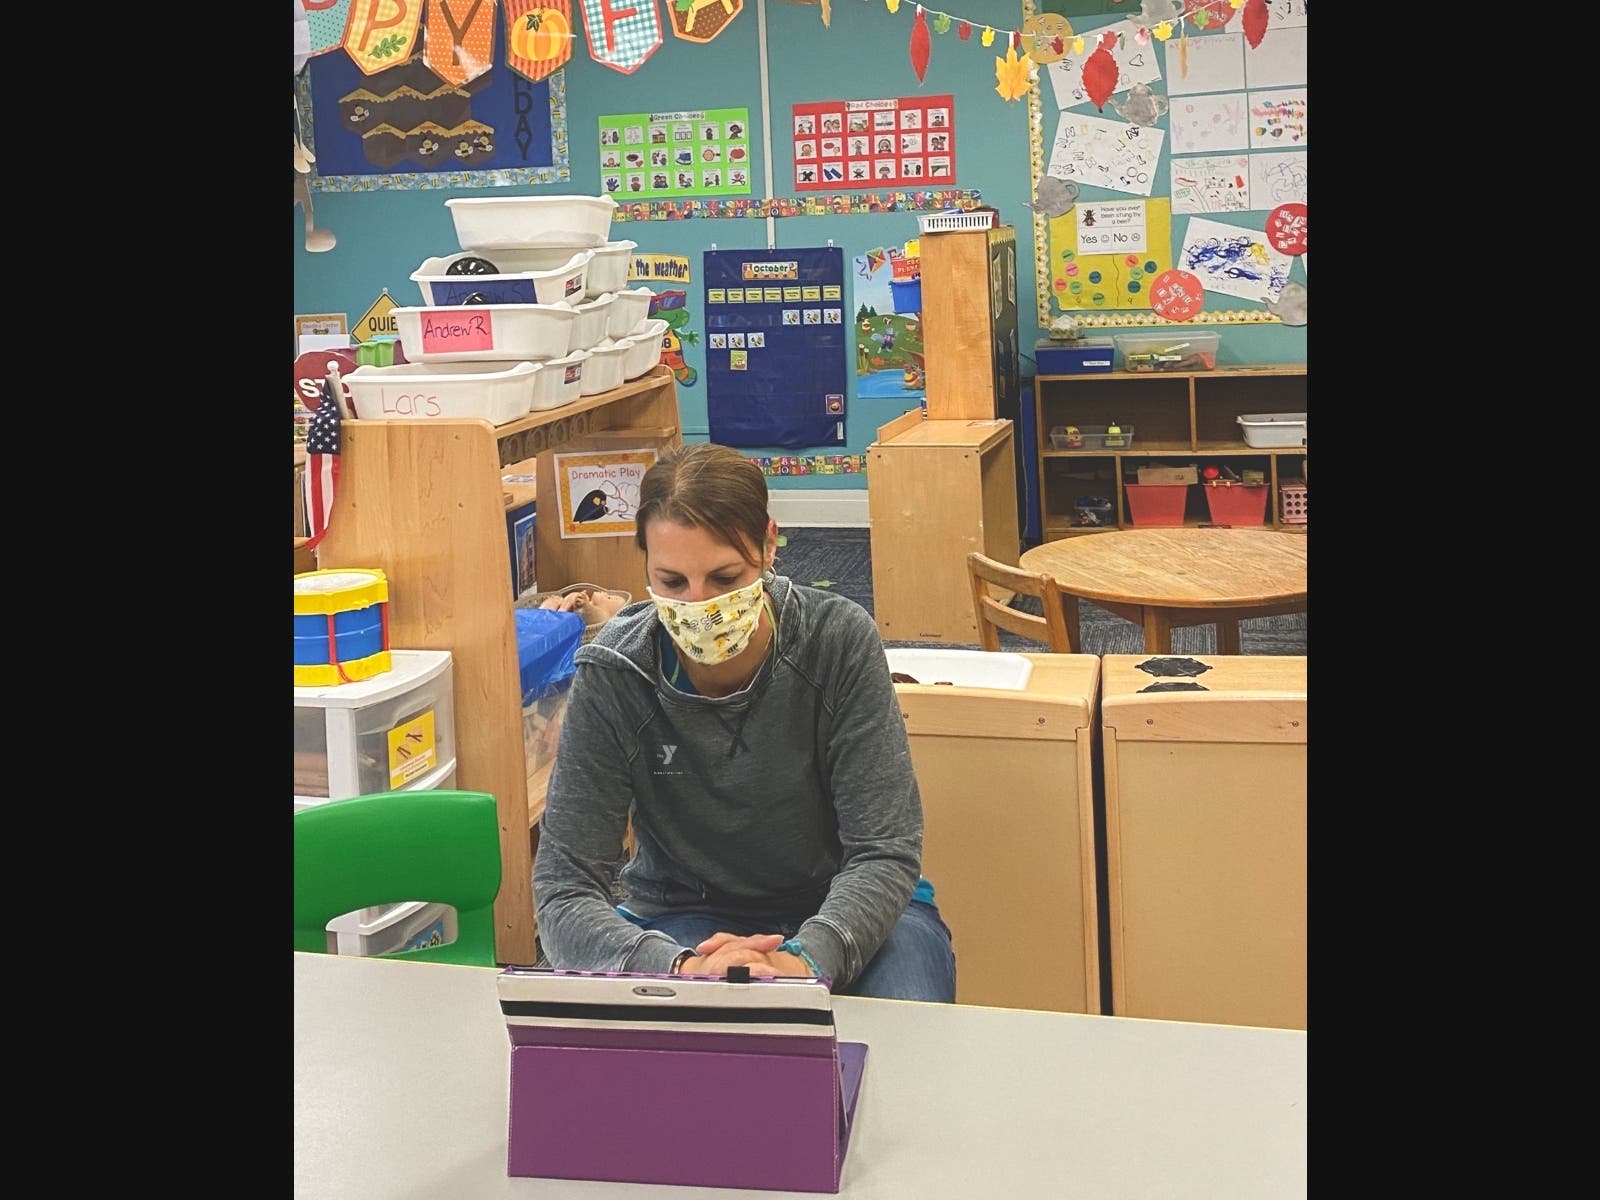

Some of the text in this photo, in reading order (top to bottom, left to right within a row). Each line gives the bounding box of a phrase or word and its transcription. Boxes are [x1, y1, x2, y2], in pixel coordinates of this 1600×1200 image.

[1081, 232, 1128, 244] Yes No
[635, 258, 688, 279] the weather
[753, 264, 789, 273] October
[368, 316, 399, 332] QUIE
[423, 315, 488, 339] Andrew R
[381, 387, 442, 417] Lars
[571, 467, 641, 481] Dramatic Play
